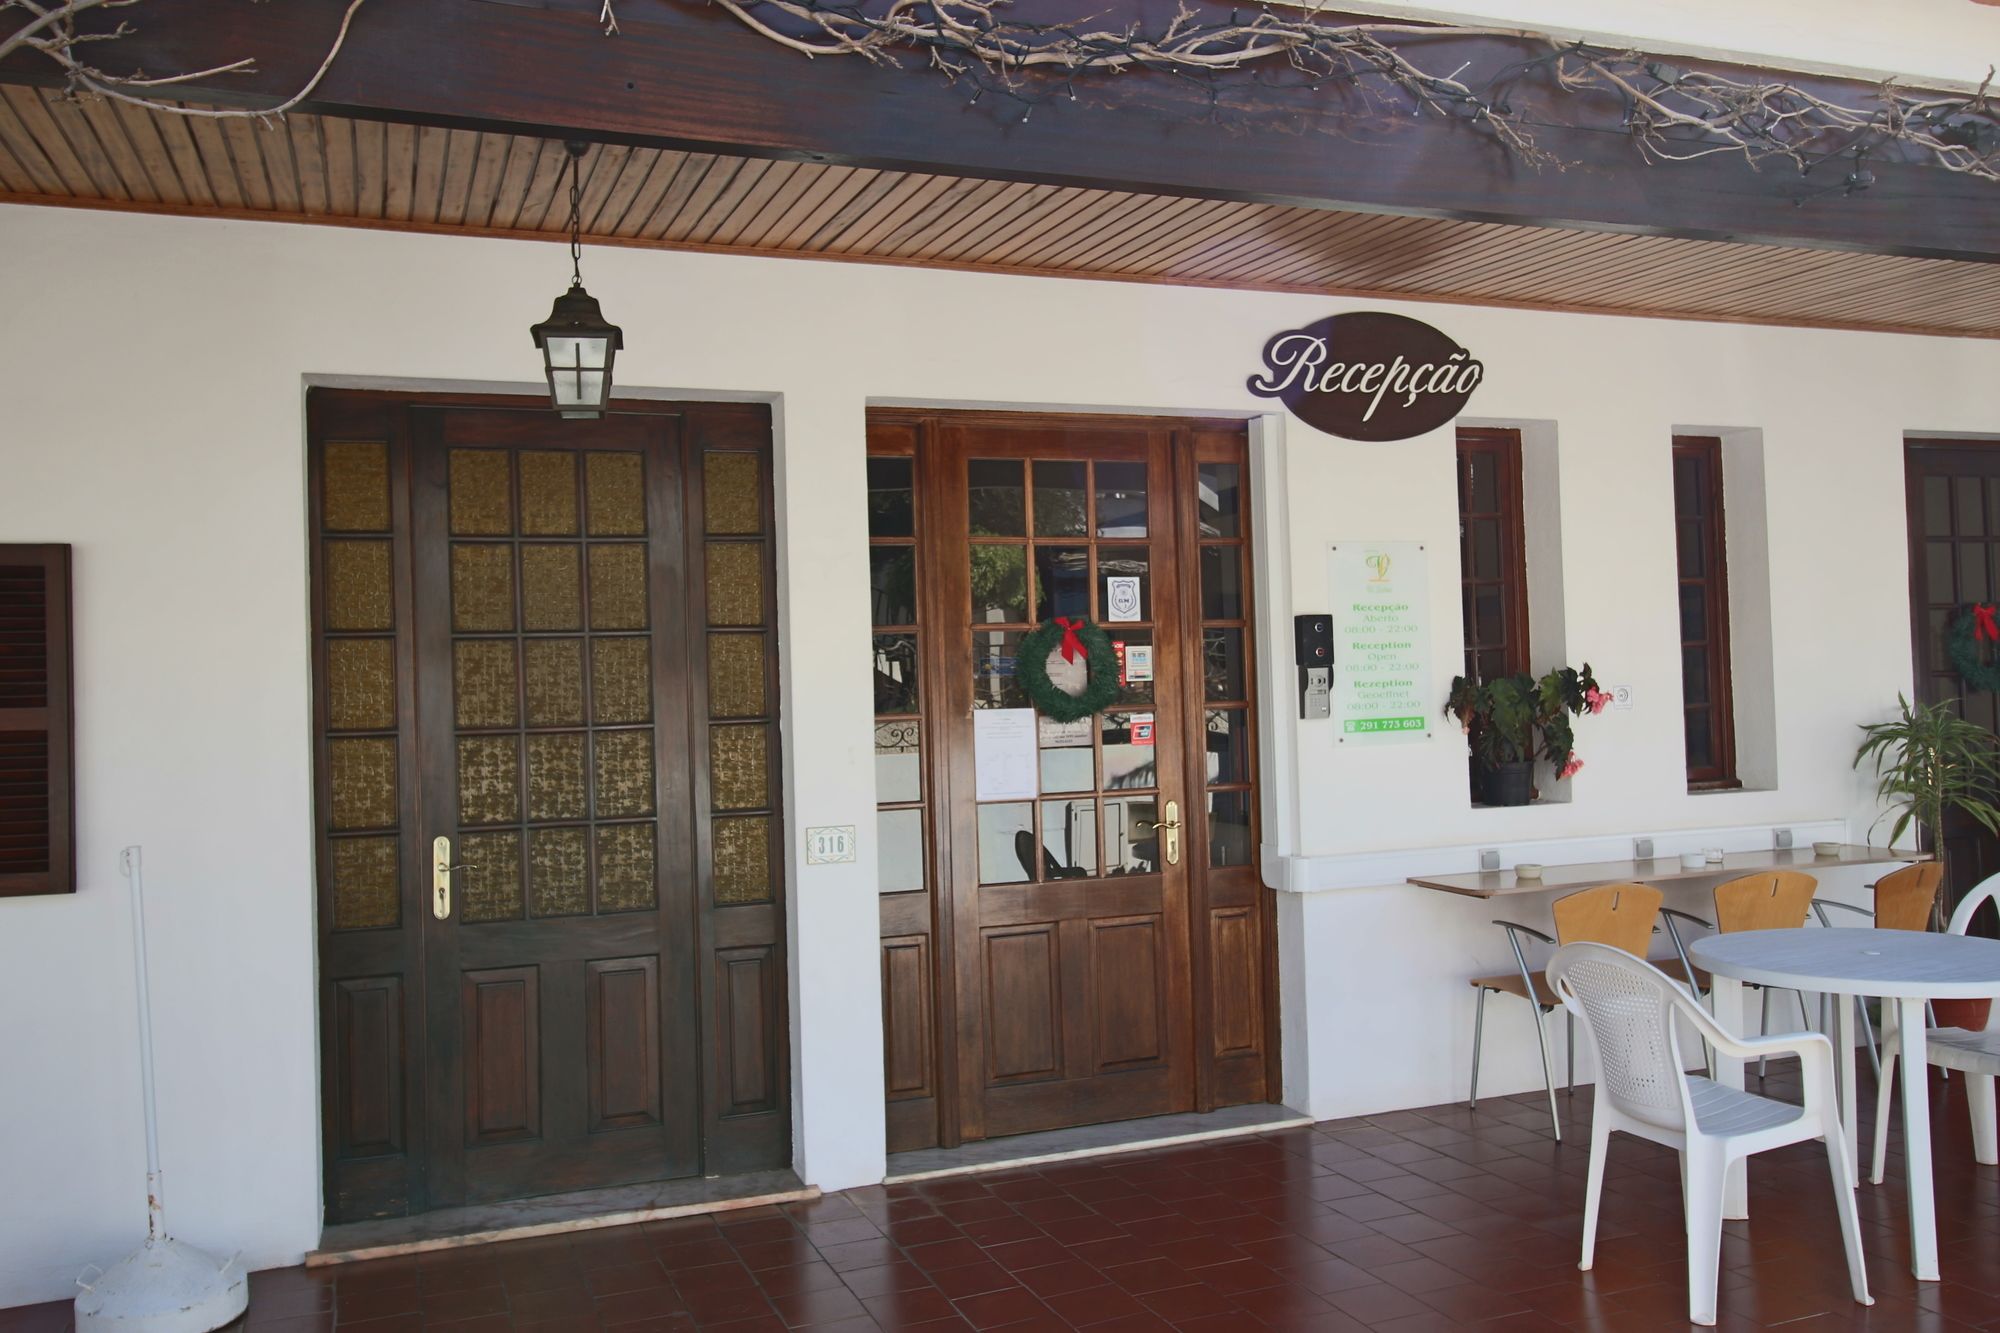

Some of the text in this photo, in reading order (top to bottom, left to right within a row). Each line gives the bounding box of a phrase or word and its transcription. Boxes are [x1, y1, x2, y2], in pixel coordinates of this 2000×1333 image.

[1255, 334, 1481, 422] Recepção
[1387, 624, 1418, 633] 22:00
[1352, 642, 1412, 651] Reception
[1367, 653, 1397, 662] Open
[1354, 680, 1413, 689] Rezeption
[1360, 721, 1378, 730] 291
[818, 835, 844, 854] 316
